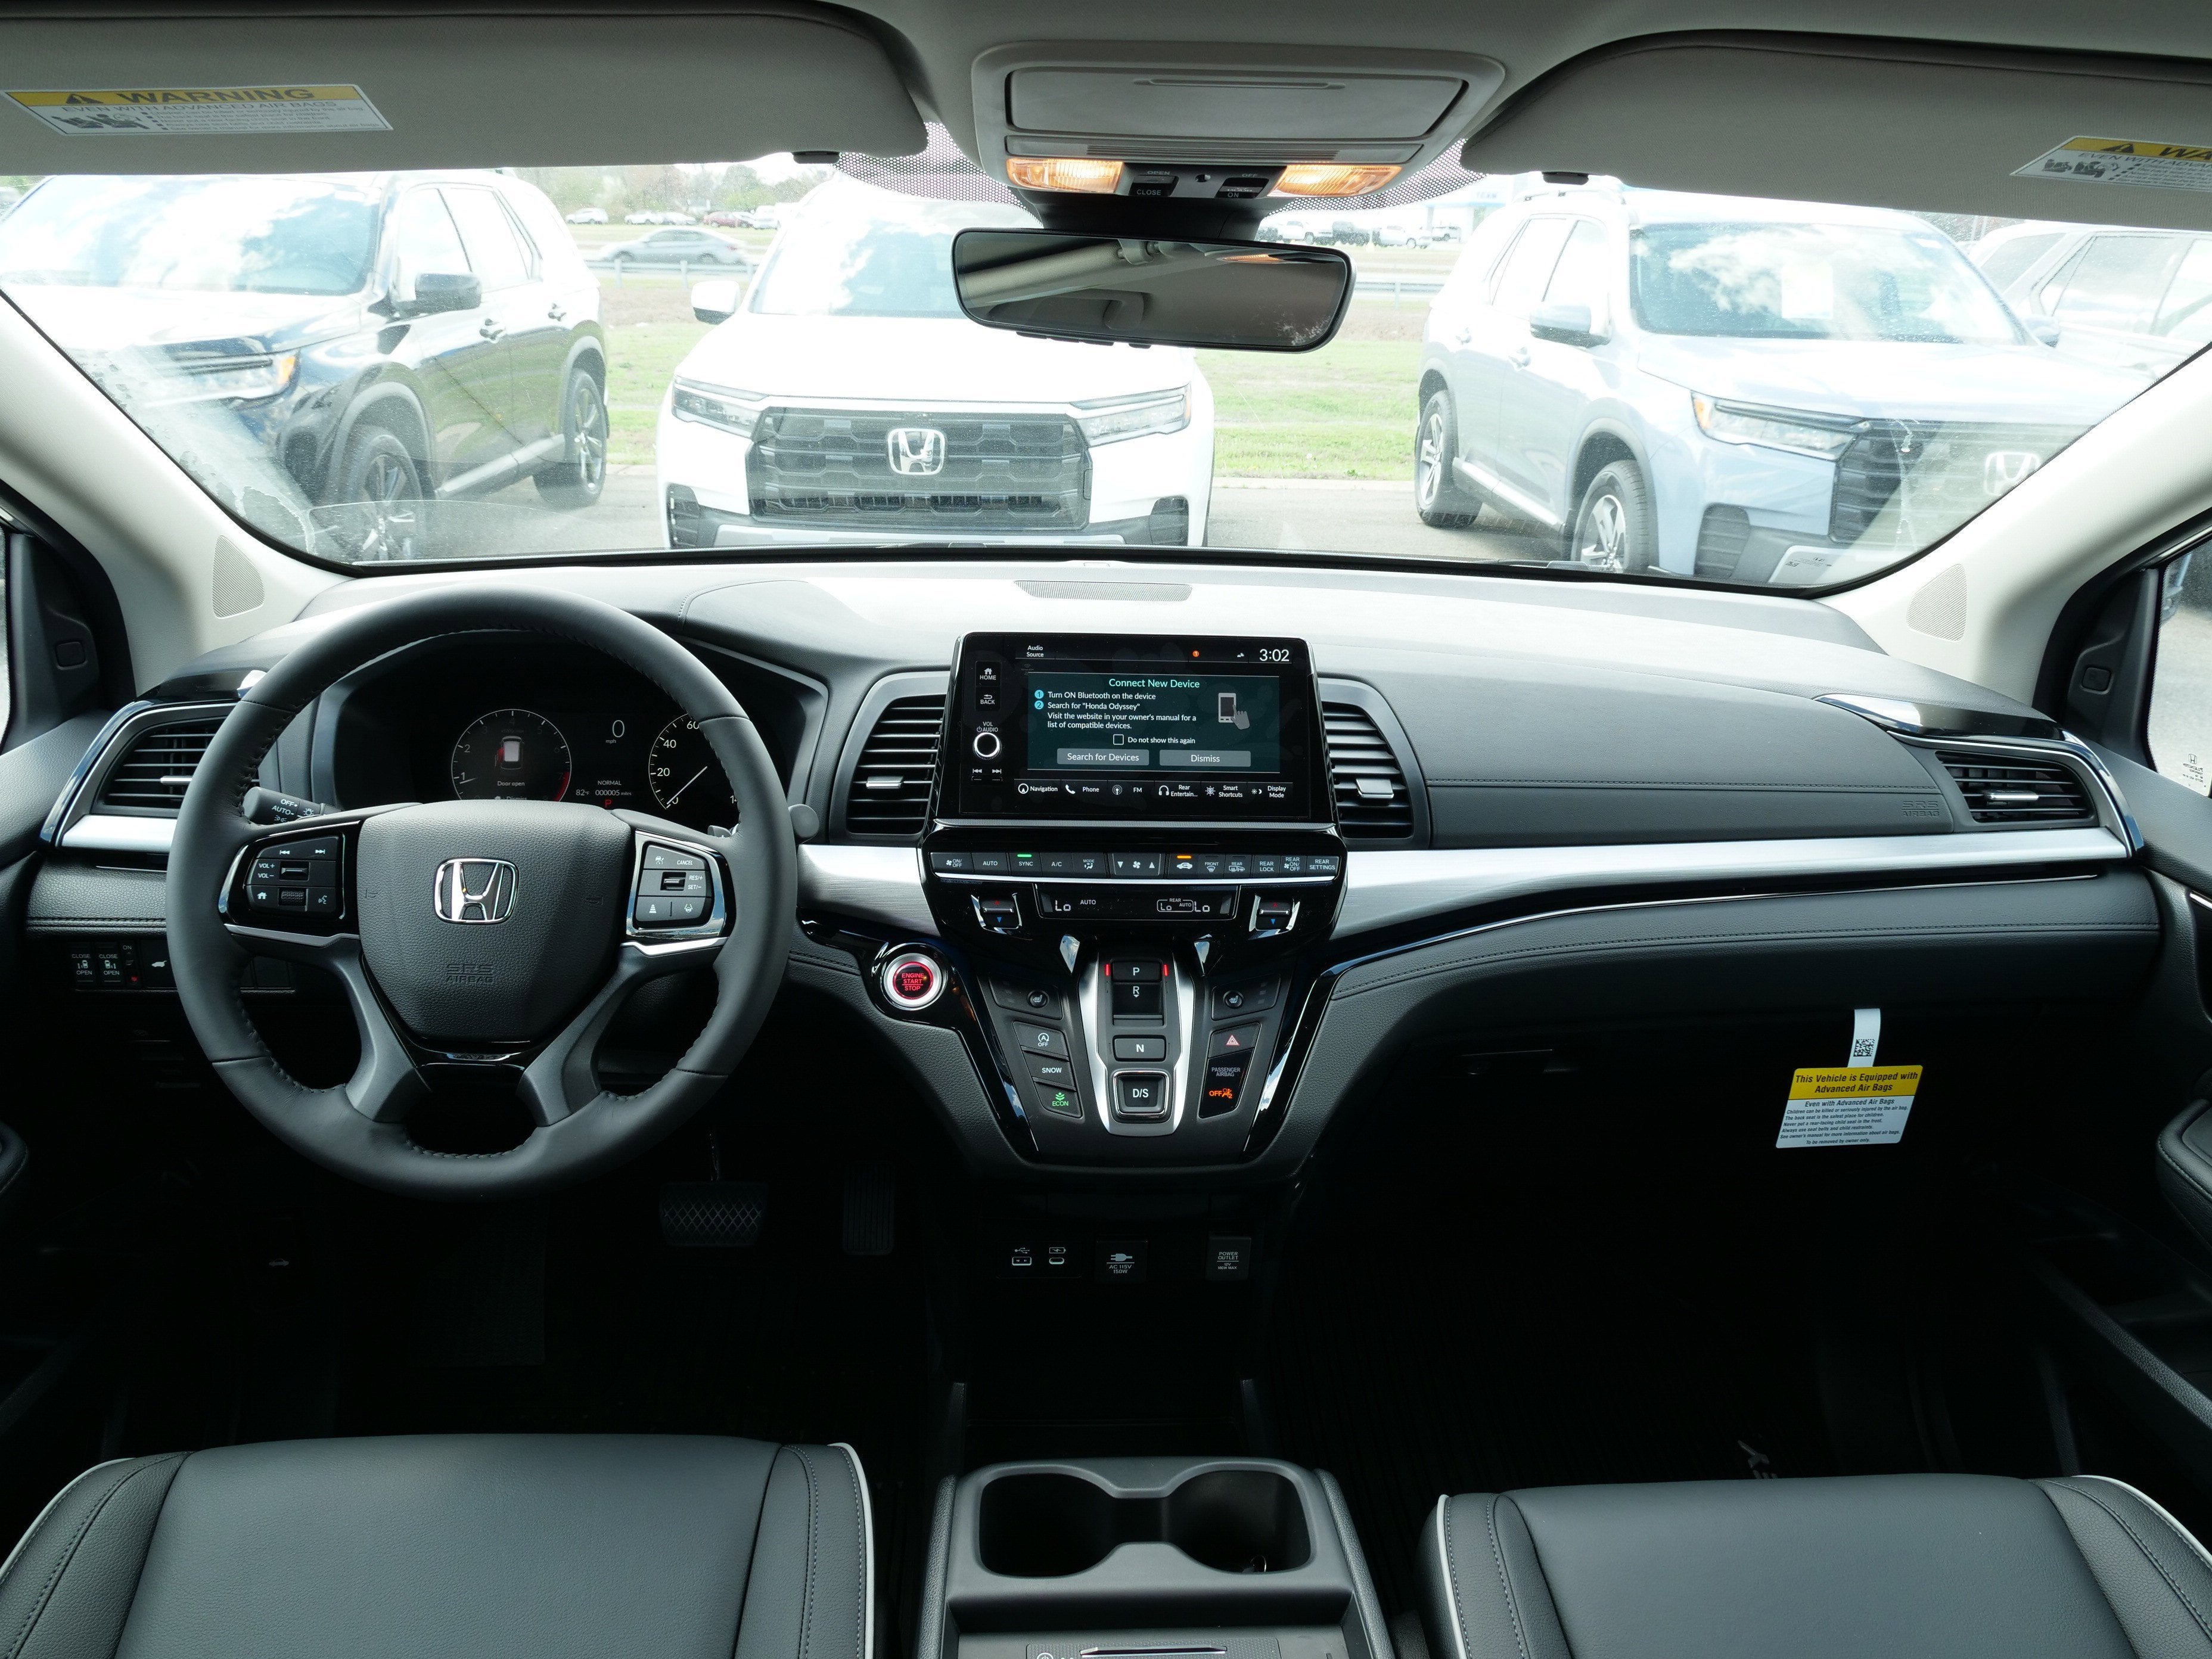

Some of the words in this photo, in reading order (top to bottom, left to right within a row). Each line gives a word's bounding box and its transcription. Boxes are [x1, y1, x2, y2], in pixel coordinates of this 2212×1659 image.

[116, 89, 315, 103] WARNING
[1260, 649, 1290, 661] 3:02
[1148, 679, 1167, 688] New
[612, 720, 625, 738] 0
[464, 744, 470, 753] 2
[663, 740, 676, 748] 40
[1067, 753, 1093, 761] Search
[461, 772, 465, 780] 1
[657, 768, 670, 776] 20
[605, 799, 611, 807] P
[272, 805, 291, 815] AUTO
[447, 964, 494, 974] SRS
[1133, 967, 1140, 975] P
[1133, 986, 1140, 995] R
[1136, 1044, 1144, 1052] N
[1859, 1073, 1899, 1082] Equipped
[1132, 1088, 1149, 1099] D/S
[1815, 1085, 1856, 1093] Advanced
